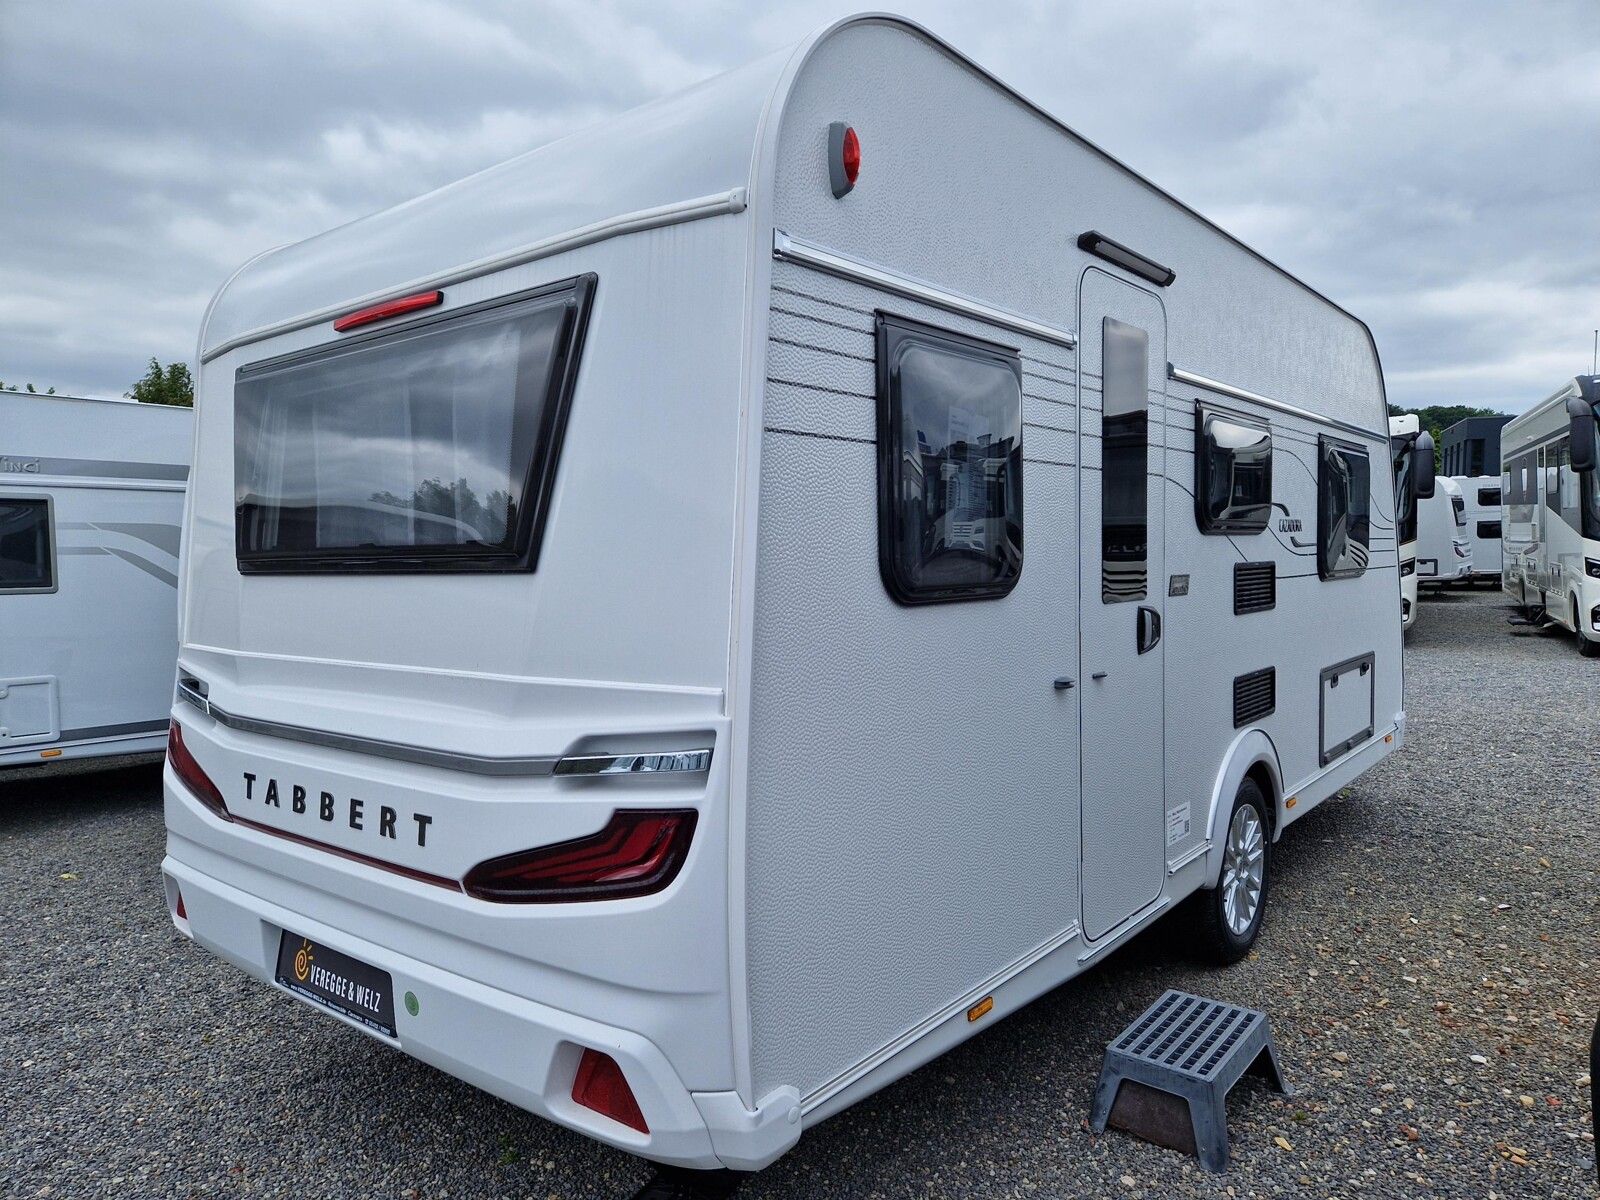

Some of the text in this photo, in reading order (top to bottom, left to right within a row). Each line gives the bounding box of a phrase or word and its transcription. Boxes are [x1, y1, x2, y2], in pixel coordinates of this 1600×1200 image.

[0, 456, 40, 473] inci
[243, 772, 432, 847] TABBERT
[310, 964, 347, 998] VEREGGE
[347, 981, 355, 1002] &
[356, 984, 381, 1013] WELZ
